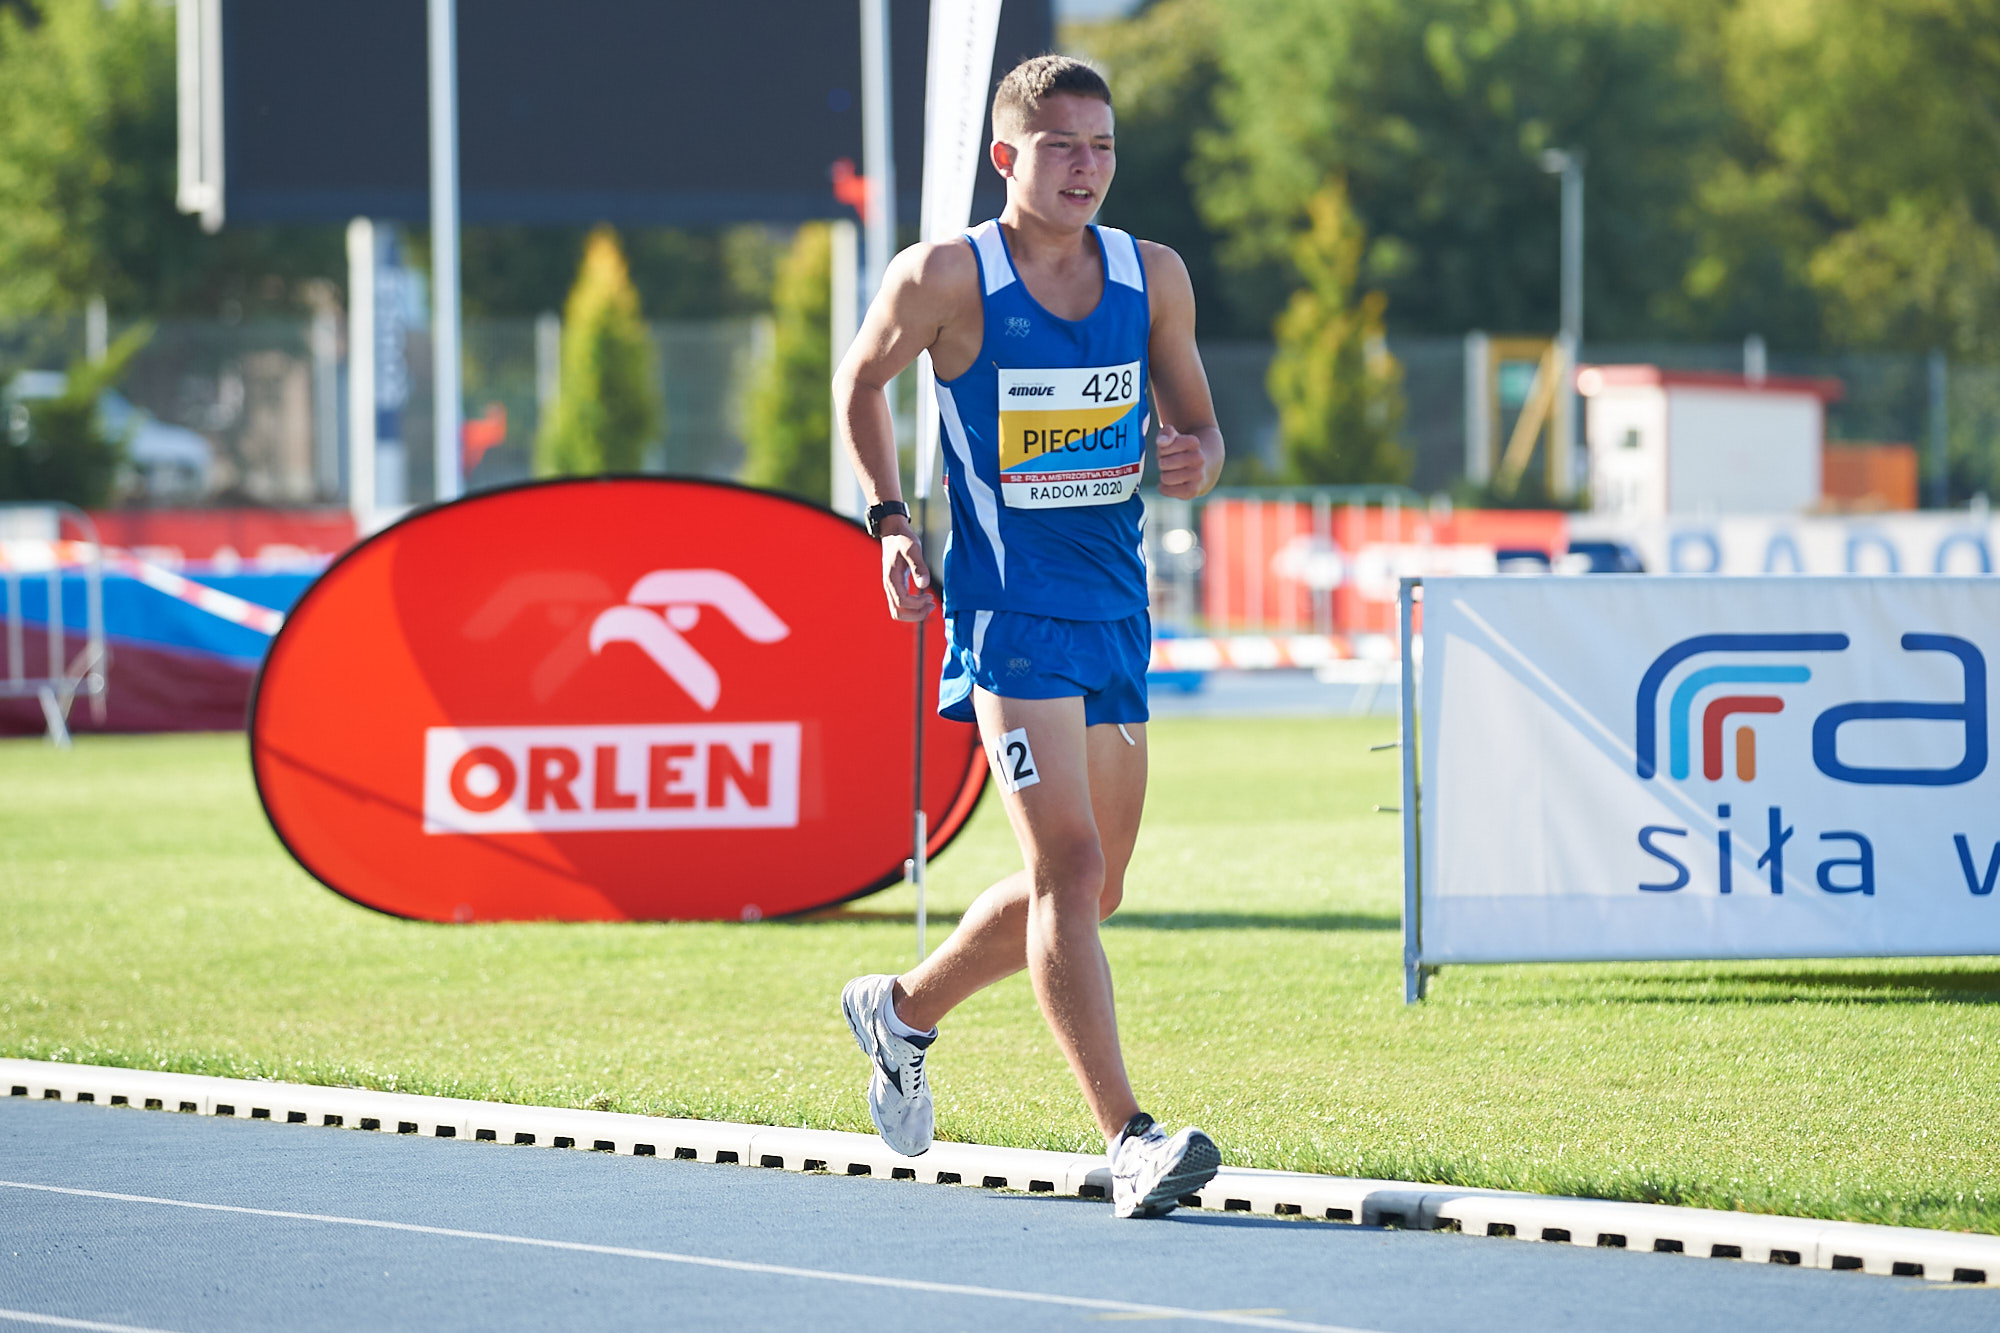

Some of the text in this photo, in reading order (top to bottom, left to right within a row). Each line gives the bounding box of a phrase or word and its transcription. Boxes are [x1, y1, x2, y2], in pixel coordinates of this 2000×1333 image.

[1008, 386, 1056, 396] 4MOVE
[1081, 370, 1132, 403] 428
[1023, 423, 1128, 454] PIECUCH
[1030, 481, 1123, 500] RADOM 2020
[1048, 471, 1101, 481] MISTRZOSTWA
[450, 742, 772, 813] ORLEN
[1638, 804, 1875, 896] siła
